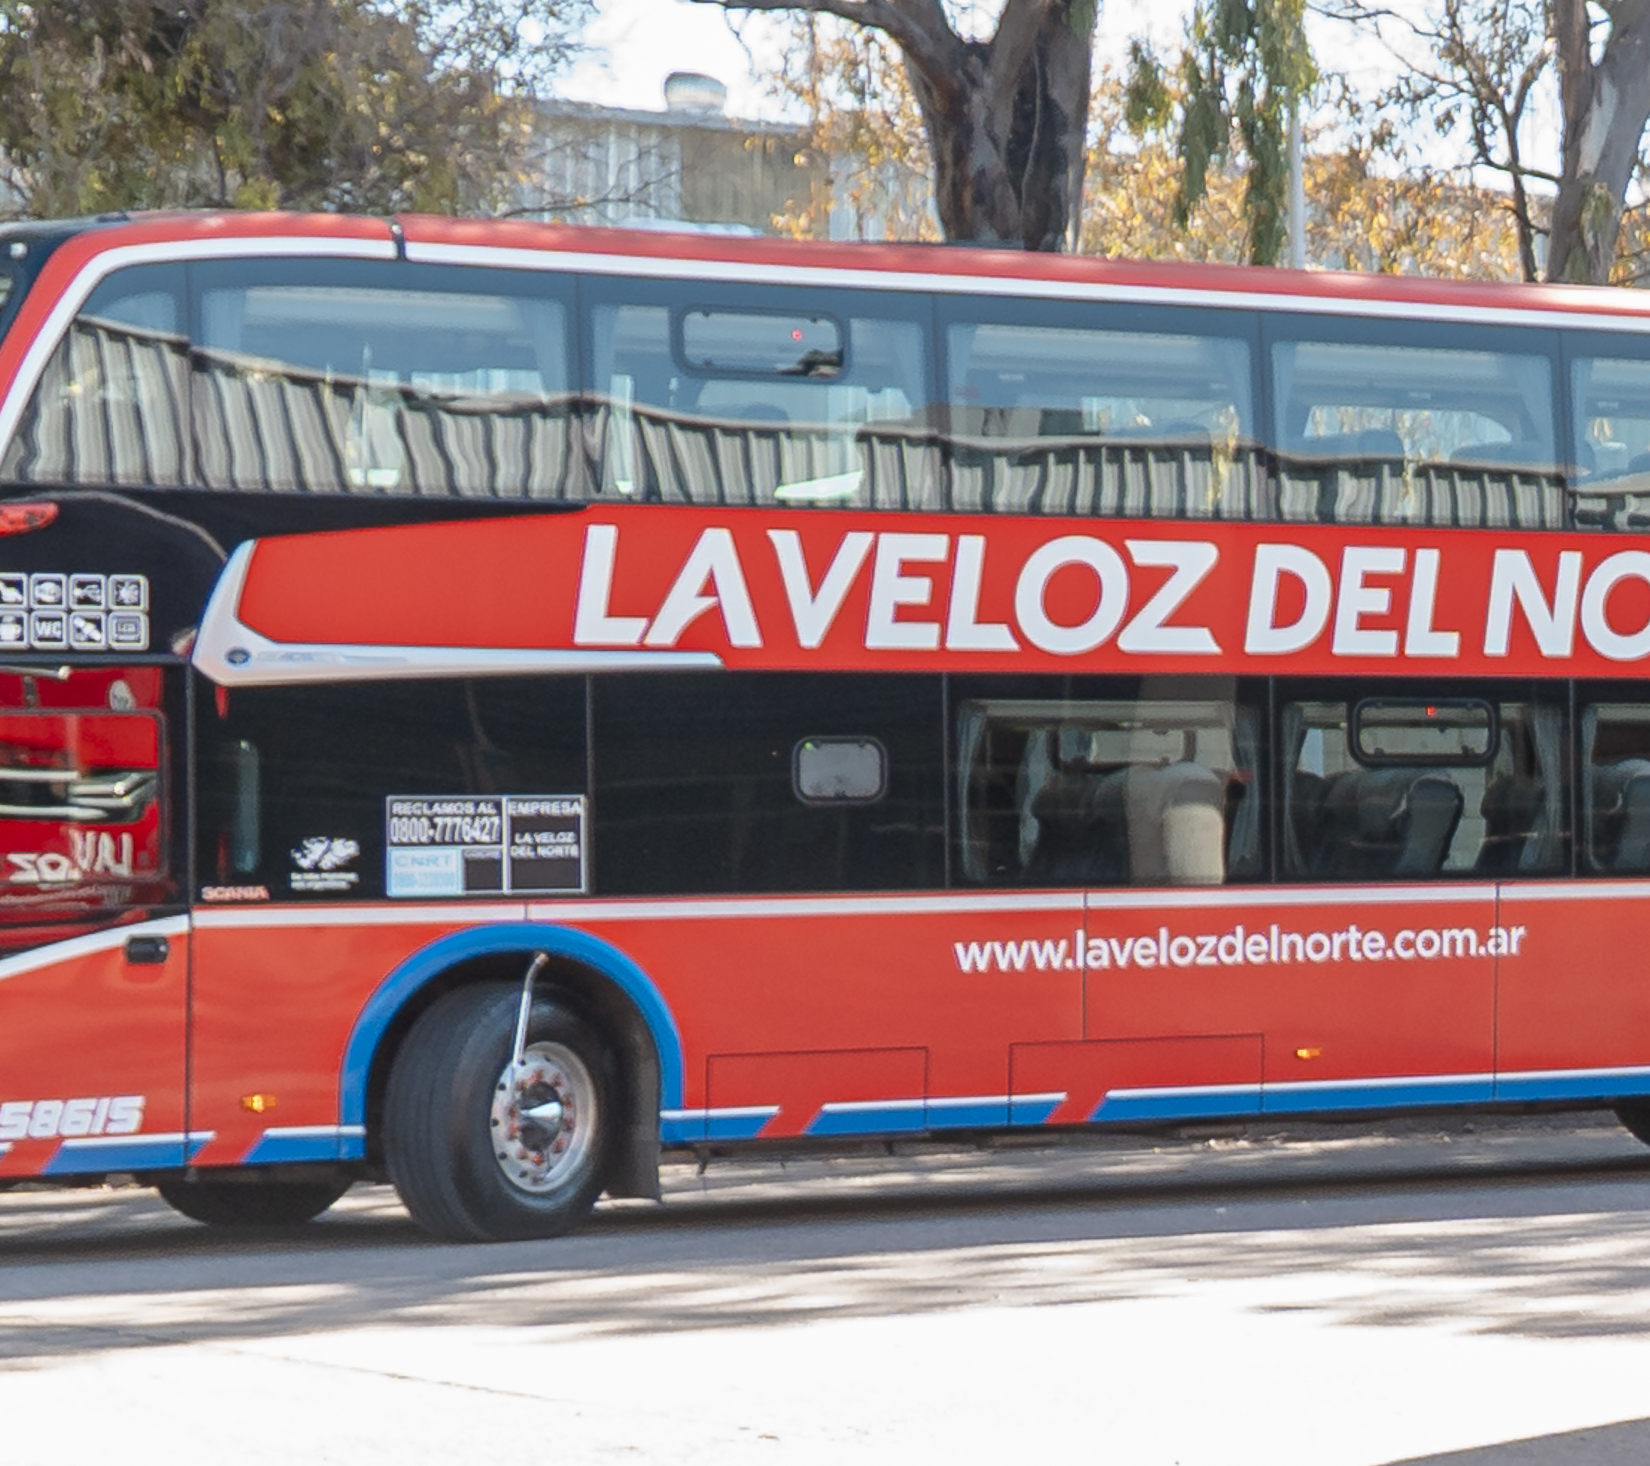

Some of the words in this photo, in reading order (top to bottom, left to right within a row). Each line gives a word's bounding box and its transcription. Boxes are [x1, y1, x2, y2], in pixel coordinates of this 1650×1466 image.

[1243, 543, 1466, 658] DEL
[392, 802, 475, 815] RECLAMOS
[477, 801, 498, 814] AL
[508, 800, 582, 817] EMPRESA
[389, 816, 500, 844] 0800-7776427
[954, 921, 1527, 972] www.lavelozdelnorte.com.ar
